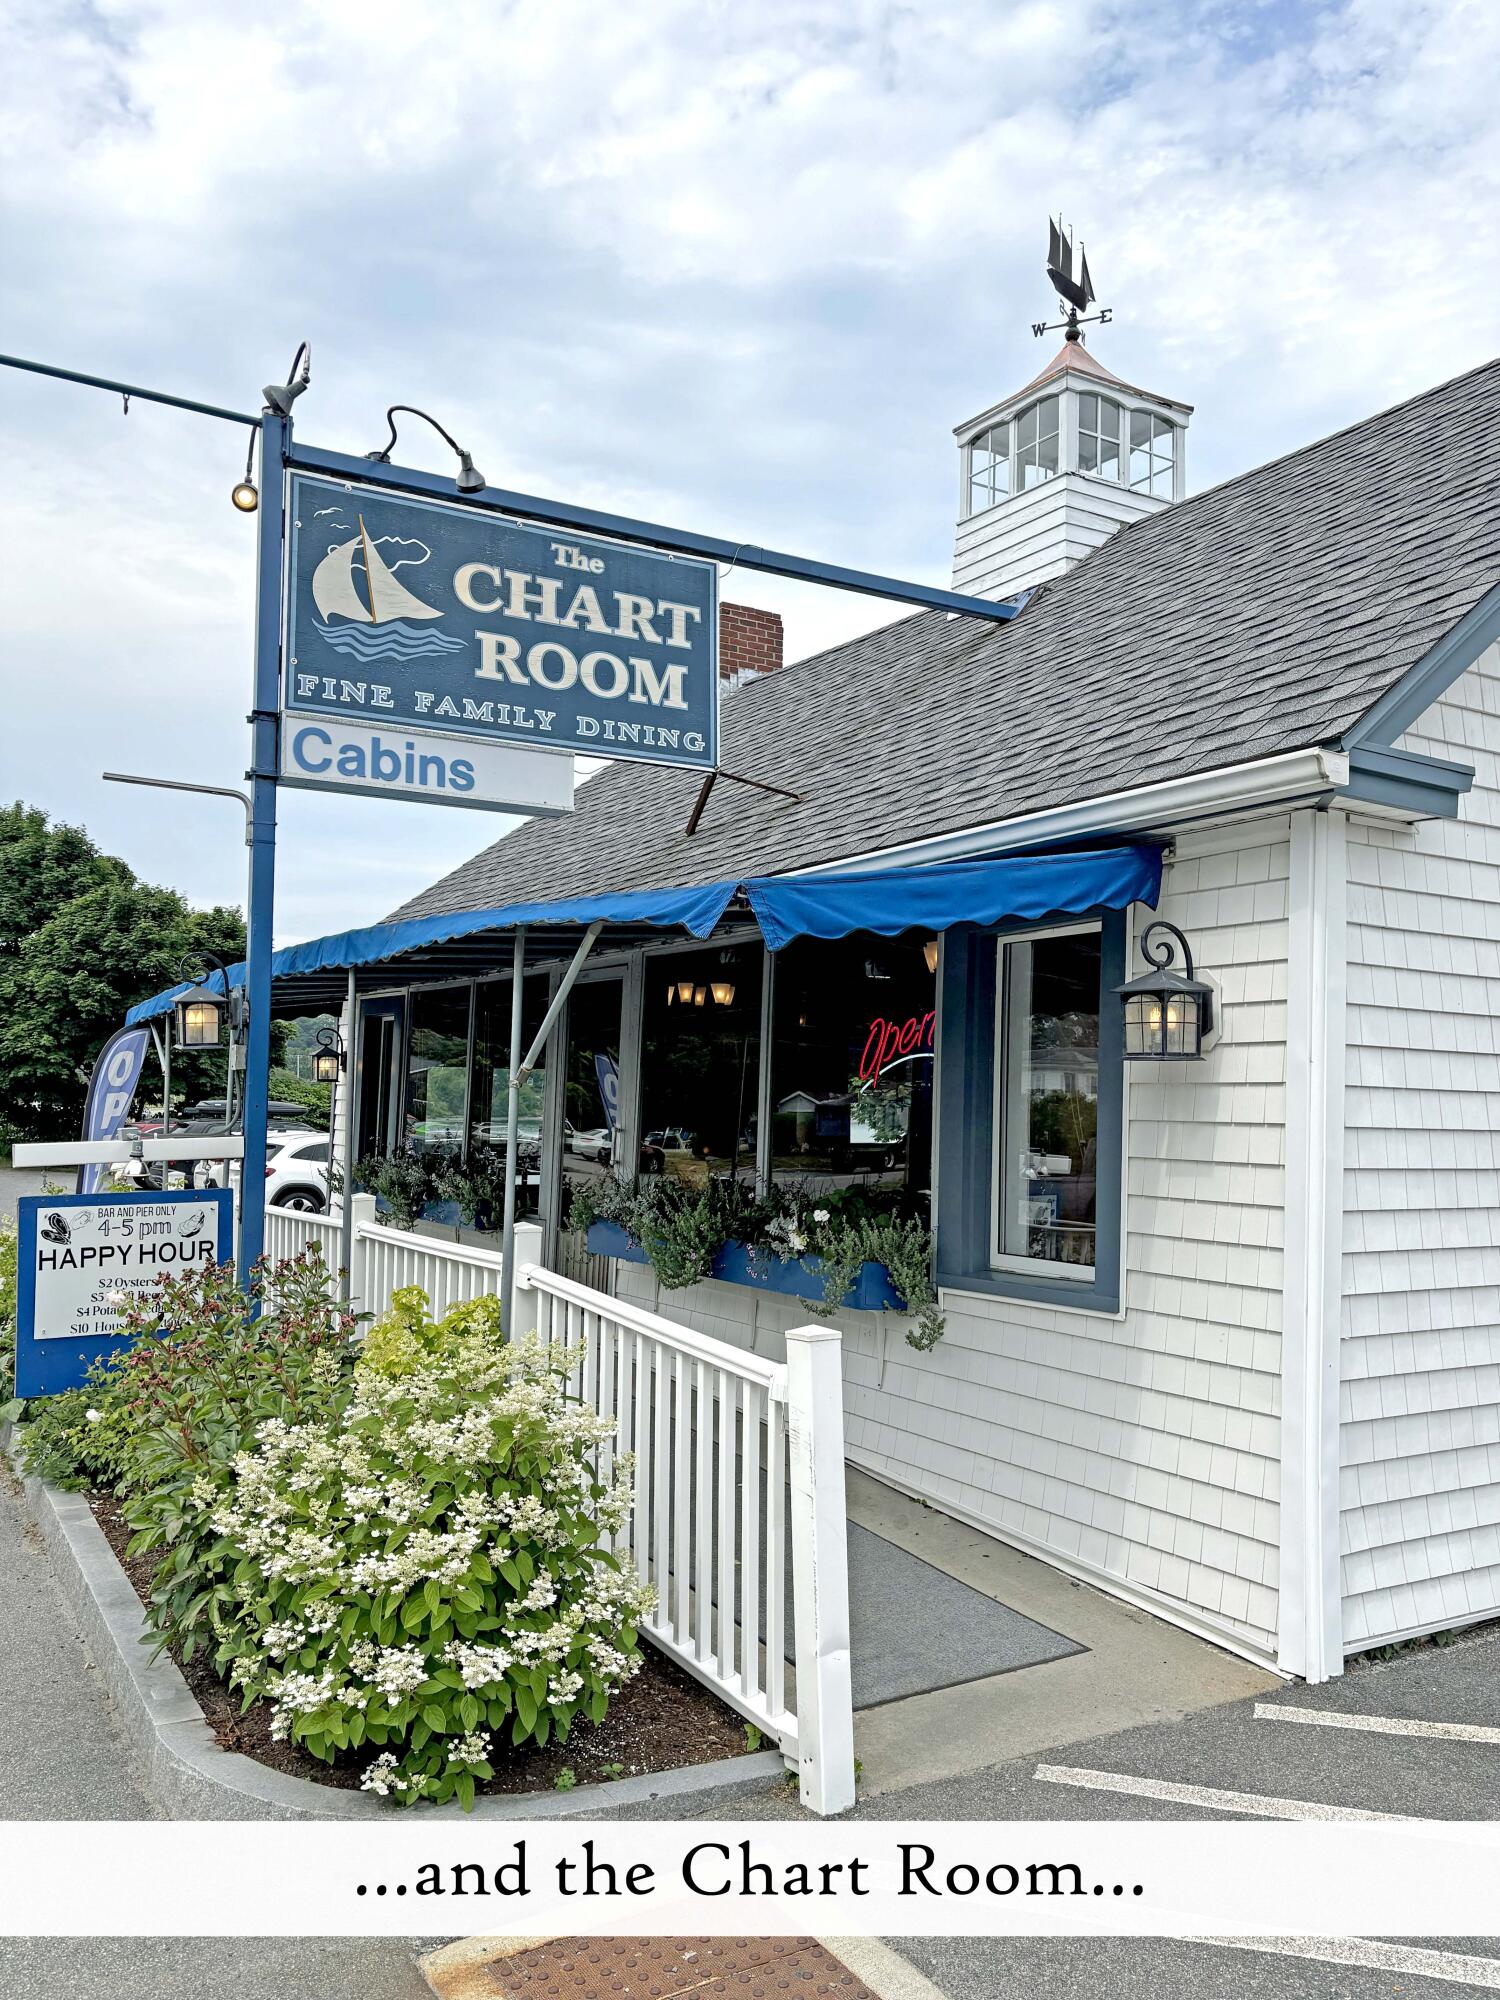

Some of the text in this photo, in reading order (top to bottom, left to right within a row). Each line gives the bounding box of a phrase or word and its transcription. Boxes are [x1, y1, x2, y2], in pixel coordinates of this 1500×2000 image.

[1032, 323, 1046, 337] W
[1100, 309, 1112, 323] E
[551, 542, 606, 575] The
[453, 562, 701, 650] CHART
[474, 630, 689, 710] ROOM
[297, 674, 706, 752] FINE FAMILY DINING
[292, 726, 476, 792] Cabins
[860, 1010, 936, 1089] Open
[97, 1205, 177, 1218] BAR AND PIER ONLY
[97, 1219, 172, 1240] 4-5 pm
[38, 1240, 215, 1271] HAPPY HOUR
[114, 1277, 156, 1289] Oysters
